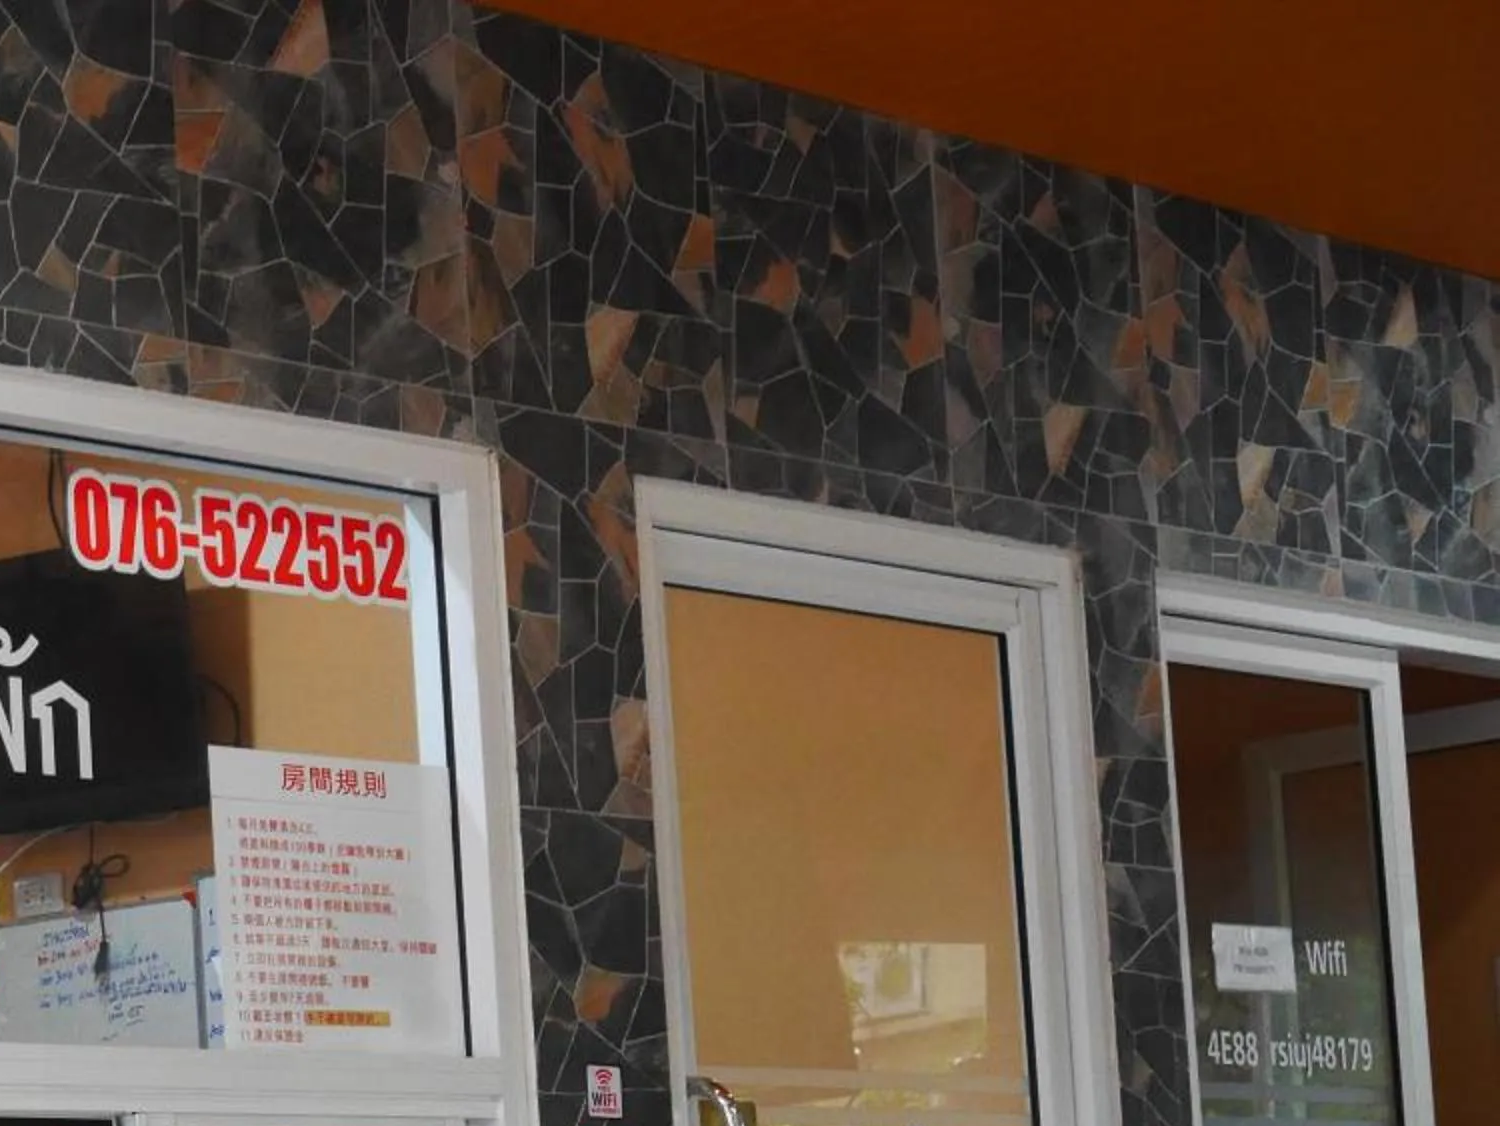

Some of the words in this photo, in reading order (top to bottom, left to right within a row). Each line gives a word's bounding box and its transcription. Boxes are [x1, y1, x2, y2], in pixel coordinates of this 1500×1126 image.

[71, 475, 408, 603] 076-522552
[281, 763, 388, 799] 房間規則
[1304, 940, 1348, 977] Wifi
[1207, 1029, 1260, 1067] 4E88
[1270, 1032, 1373, 1078] rsiuj48179
